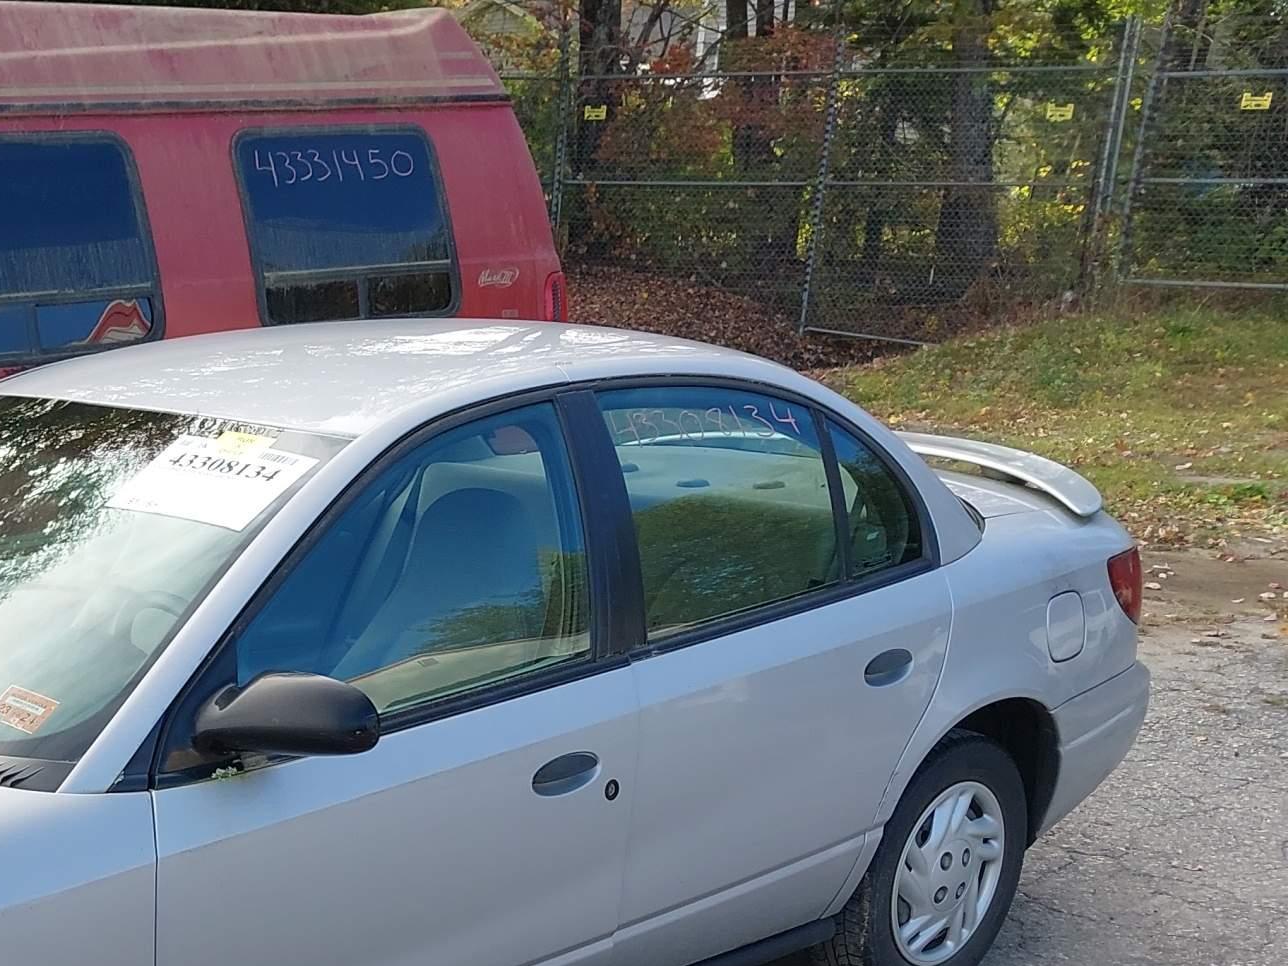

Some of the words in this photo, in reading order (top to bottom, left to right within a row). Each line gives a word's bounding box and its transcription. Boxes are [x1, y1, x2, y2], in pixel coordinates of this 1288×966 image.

[254, 150, 414, 187] 43331450
[611, 402, 800, 448] 43308134
[168, 452, 282, 482] 43308134
